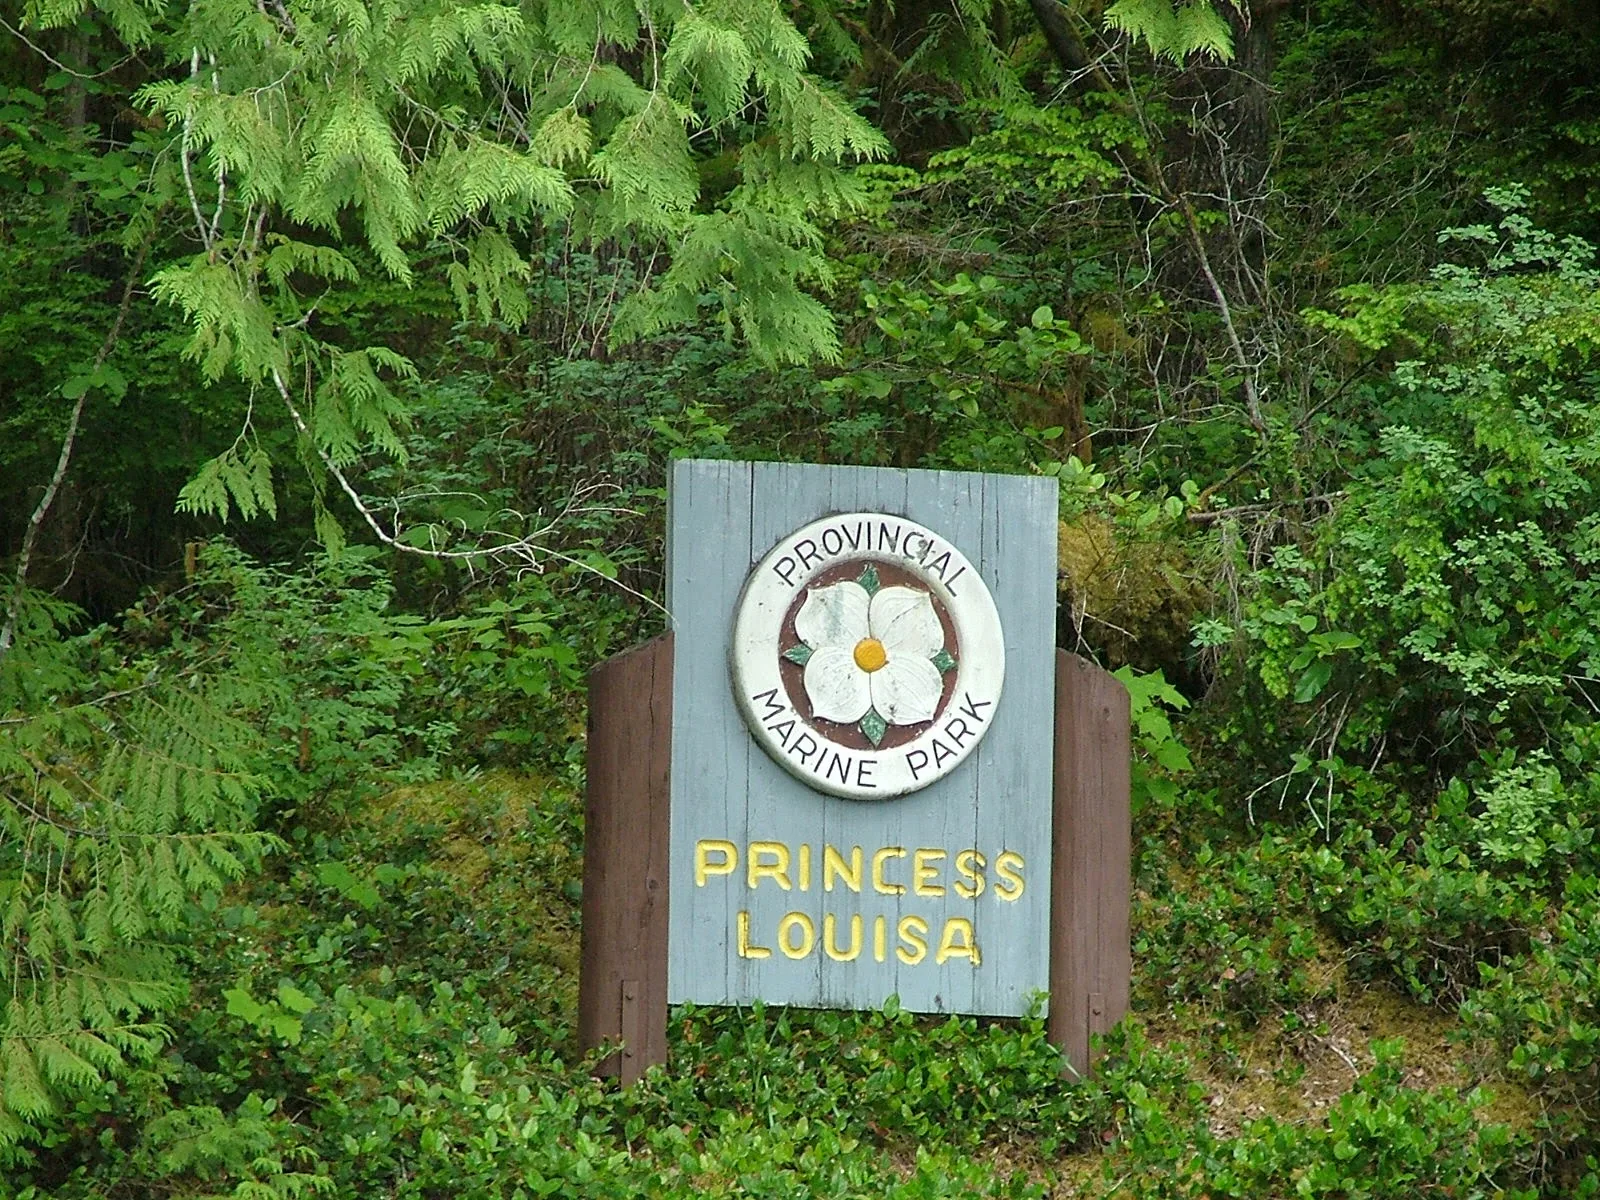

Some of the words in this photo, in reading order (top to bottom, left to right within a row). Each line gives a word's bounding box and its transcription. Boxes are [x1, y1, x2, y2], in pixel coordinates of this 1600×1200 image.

[772, 521, 967, 597] PROVINCIAL
[752, 688, 877, 788] MARINE
[906, 692, 991, 780] PARK
[695, 839, 1025, 902] PRINCESS
[736, 909, 982, 967] LOUISA
